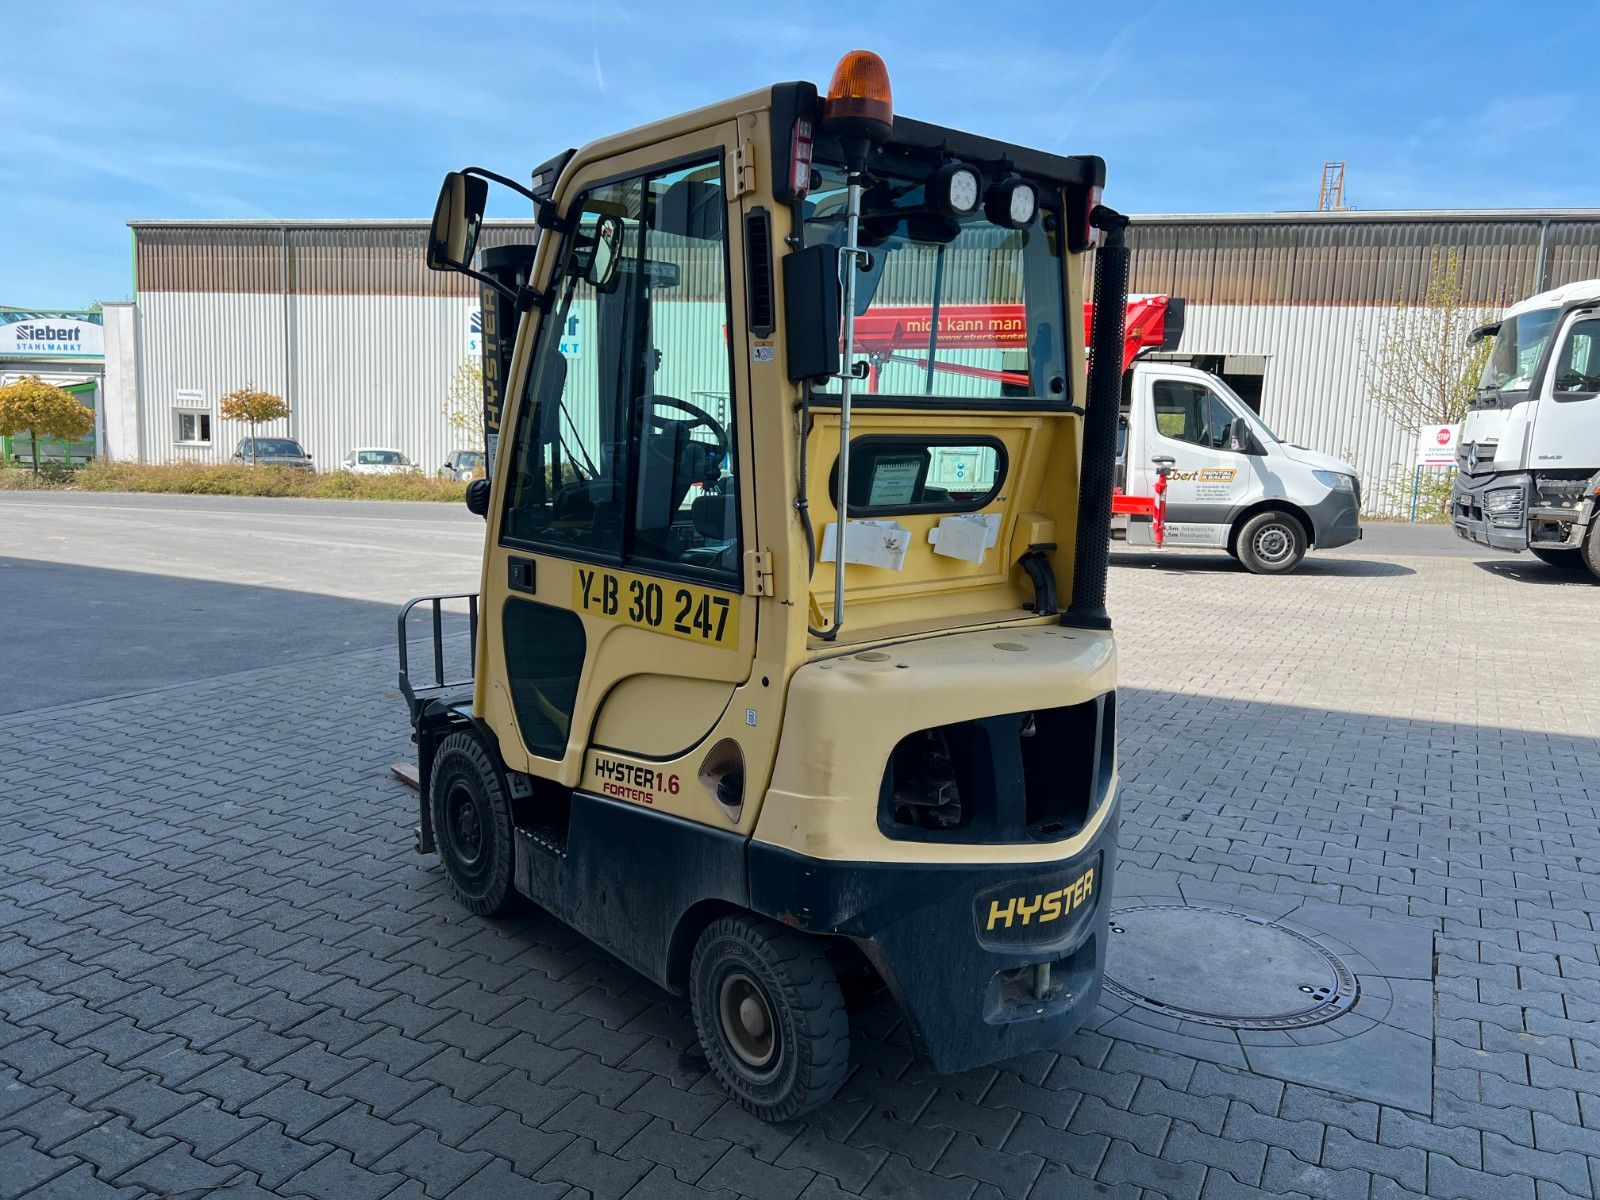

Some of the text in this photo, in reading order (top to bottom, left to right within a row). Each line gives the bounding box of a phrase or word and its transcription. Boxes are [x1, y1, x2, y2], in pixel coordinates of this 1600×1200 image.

[16, 325, 81, 341] Siebert
[947, 317, 983, 331] kann
[988, 319, 1021, 331] man
[16, 343, 82, 352] STAHLMARKT
[484, 288, 499, 430] HYSTER
[579, 569, 730, 642] Y-B 30 247
[595, 758, 680, 795] HYSTER 1.6
[603, 782, 653, 804] FORTENS
[986, 868, 1094, 931] HYSTER
